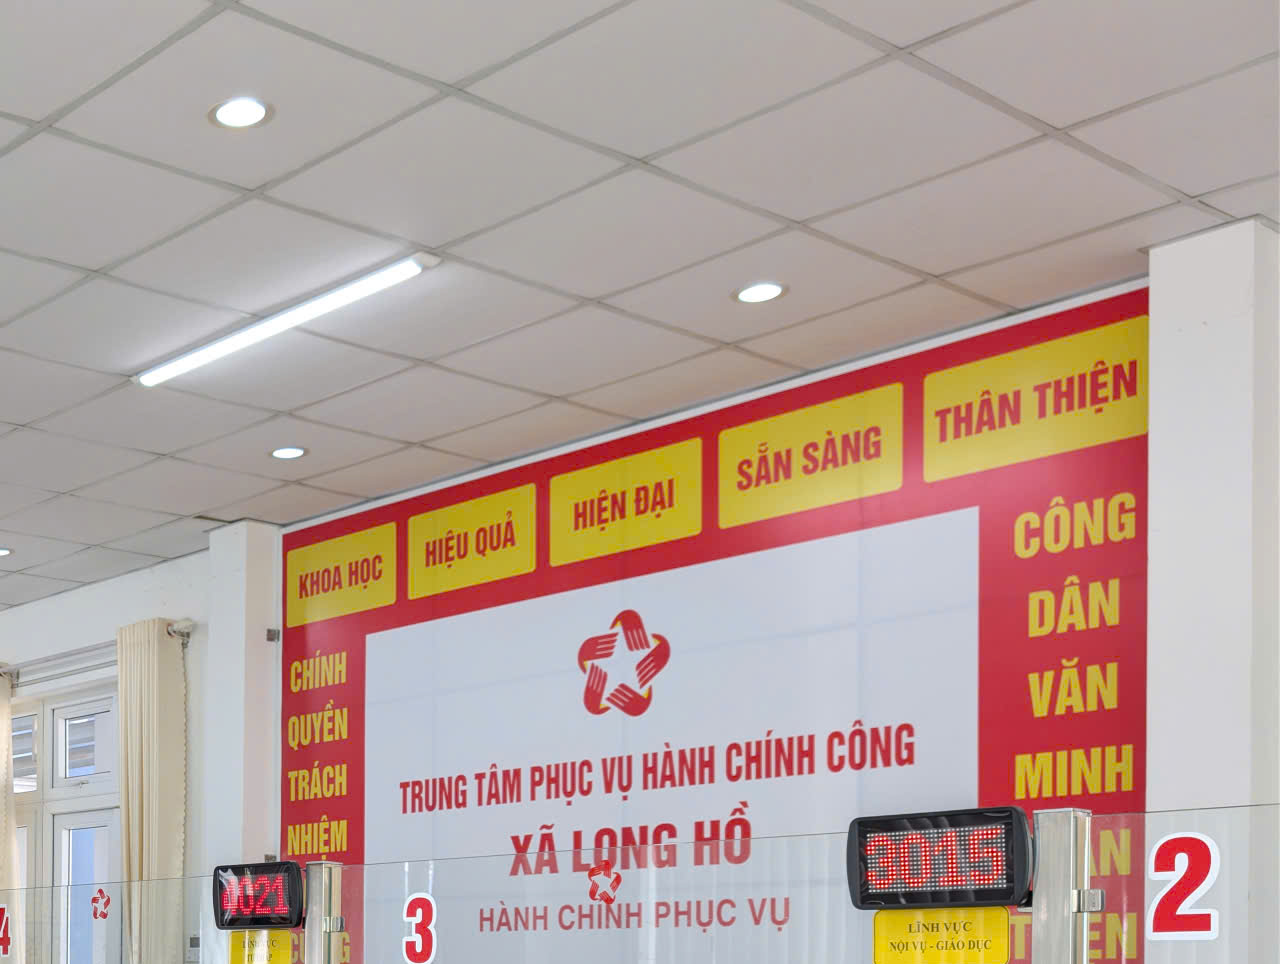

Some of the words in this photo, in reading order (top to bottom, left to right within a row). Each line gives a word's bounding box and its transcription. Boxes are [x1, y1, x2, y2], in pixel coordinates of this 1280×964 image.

[934, 390, 1021, 444] THÂN
[1032, 359, 1138, 420] THIỆN
[736, 442, 793, 492] SẴN
[801, 425, 882, 478] SÀNG
[573, 488, 627, 533] HIỆN
[634, 478, 676, 520] ĐẠI
[1013, 492, 1137, 560] CÔNG
[425, 529, 469, 570] HIỆU
[474, 510, 516, 558] QUẢ
[298, 565, 343, 599] KHOA
[348, 554, 384, 590] HỌC
[1028, 575, 1120, 638] DÂN
[290, 651, 347, 693] CHÍNH
[1027, 656, 1119, 719] VĂN
[287, 700, 349, 751] QUYỀN
[288, 761, 348, 802] TRÁCH
[400, 774, 467, 814] TRUNG
[475, 763, 521, 808] TÂM
[530, 759, 593, 806] PHỤC
[601, 755, 634, 801] VỤ
[642, 742, 715, 790] HÀNH
[725, 729, 816, 782] CHÍNH
[826, 719, 915, 773] CÔNG
[1014, 744, 1134, 800] MINH
[287, 815, 348, 864] NHIỆM
[509, 823, 559, 877] XÃ
[571, 823, 678, 874] LONG
[693, 801, 751, 867] HỒ
[865, 826, 1004, 890] 3015
[222, 875, 289, 915] 4021
[1150, 833, 1216, 937] 2
[478, 900, 548, 933] HÀNH
[654, 898, 736, 933] PHỤC
[748, 896, 790, 932] VỤ
[908, 921, 940, 933] LĨNH
[944, 920, 973, 935] VỰC
[889, 940, 909, 954] NỘI
[912, 941, 927, 954] VỤ
[936, 937, 965, 951] GIÁO
[968, 939, 992, 952] DỤC
